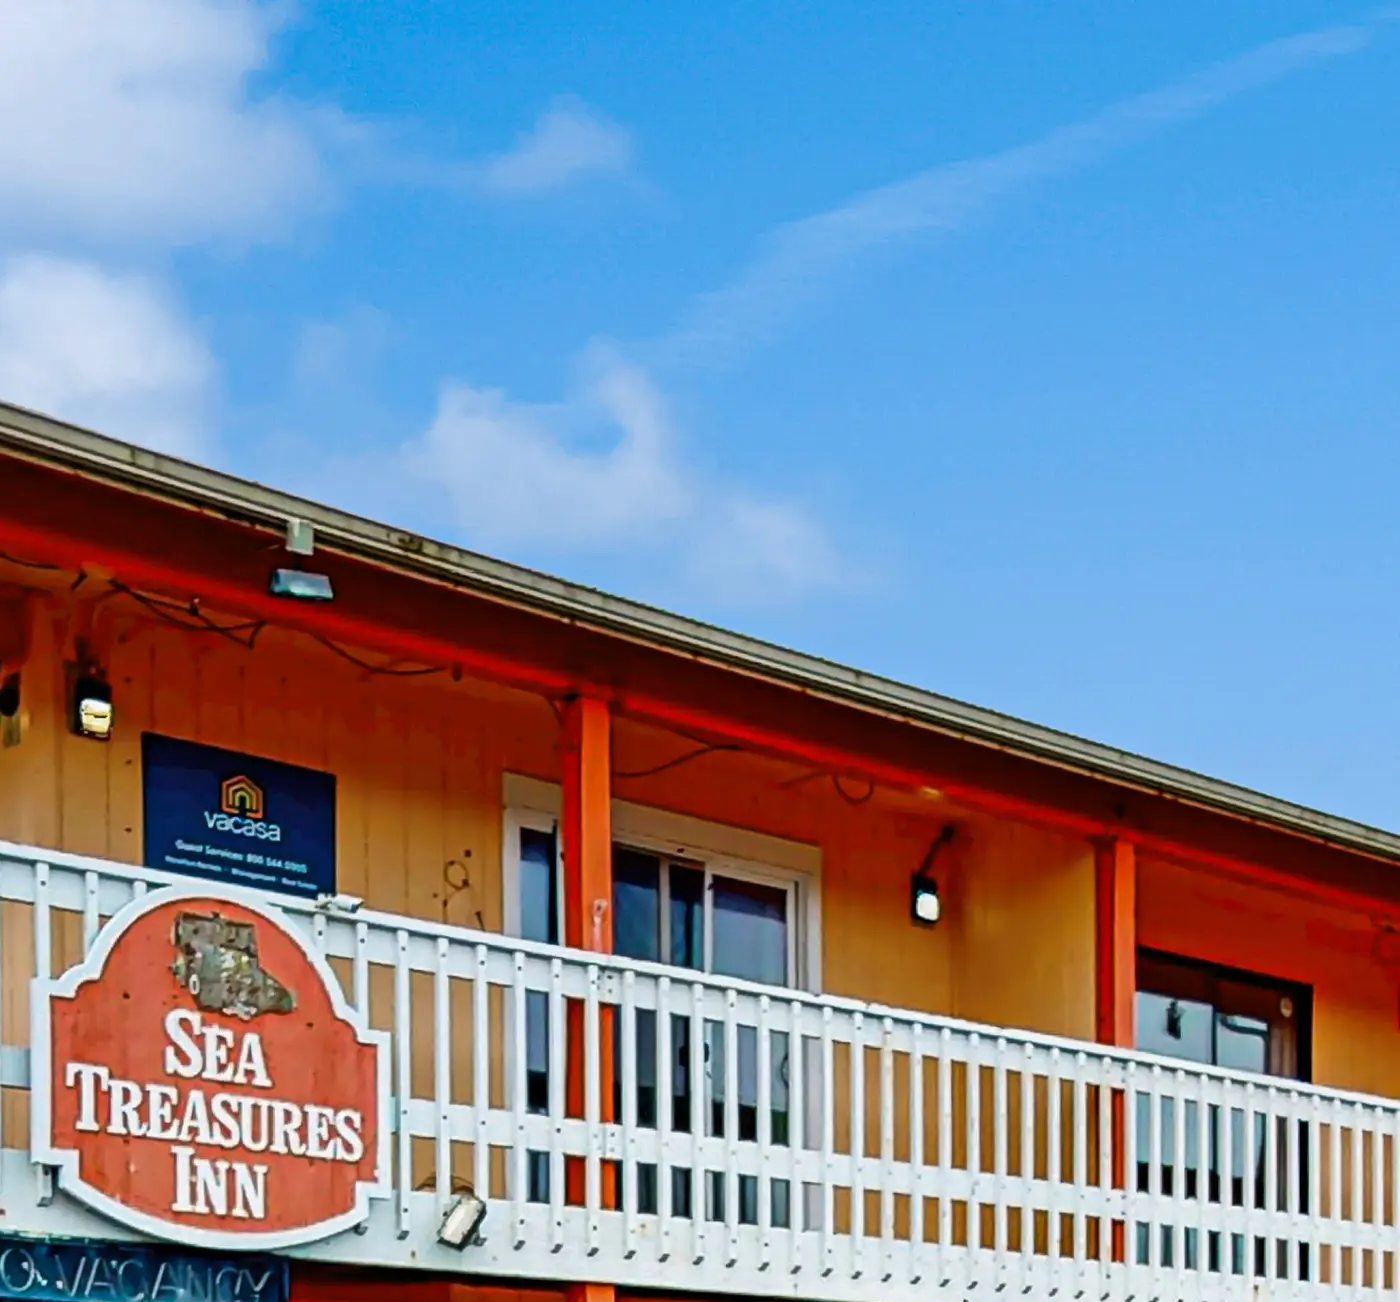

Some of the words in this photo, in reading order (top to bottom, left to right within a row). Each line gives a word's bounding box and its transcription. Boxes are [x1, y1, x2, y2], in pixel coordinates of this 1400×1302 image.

[204, 811, 281, 841] vacasa
[164, 1008, 273, 1088] SEA
[65, 1062, 364, 1162] TREASURES
[170, 1145, 269, 1219] INN
